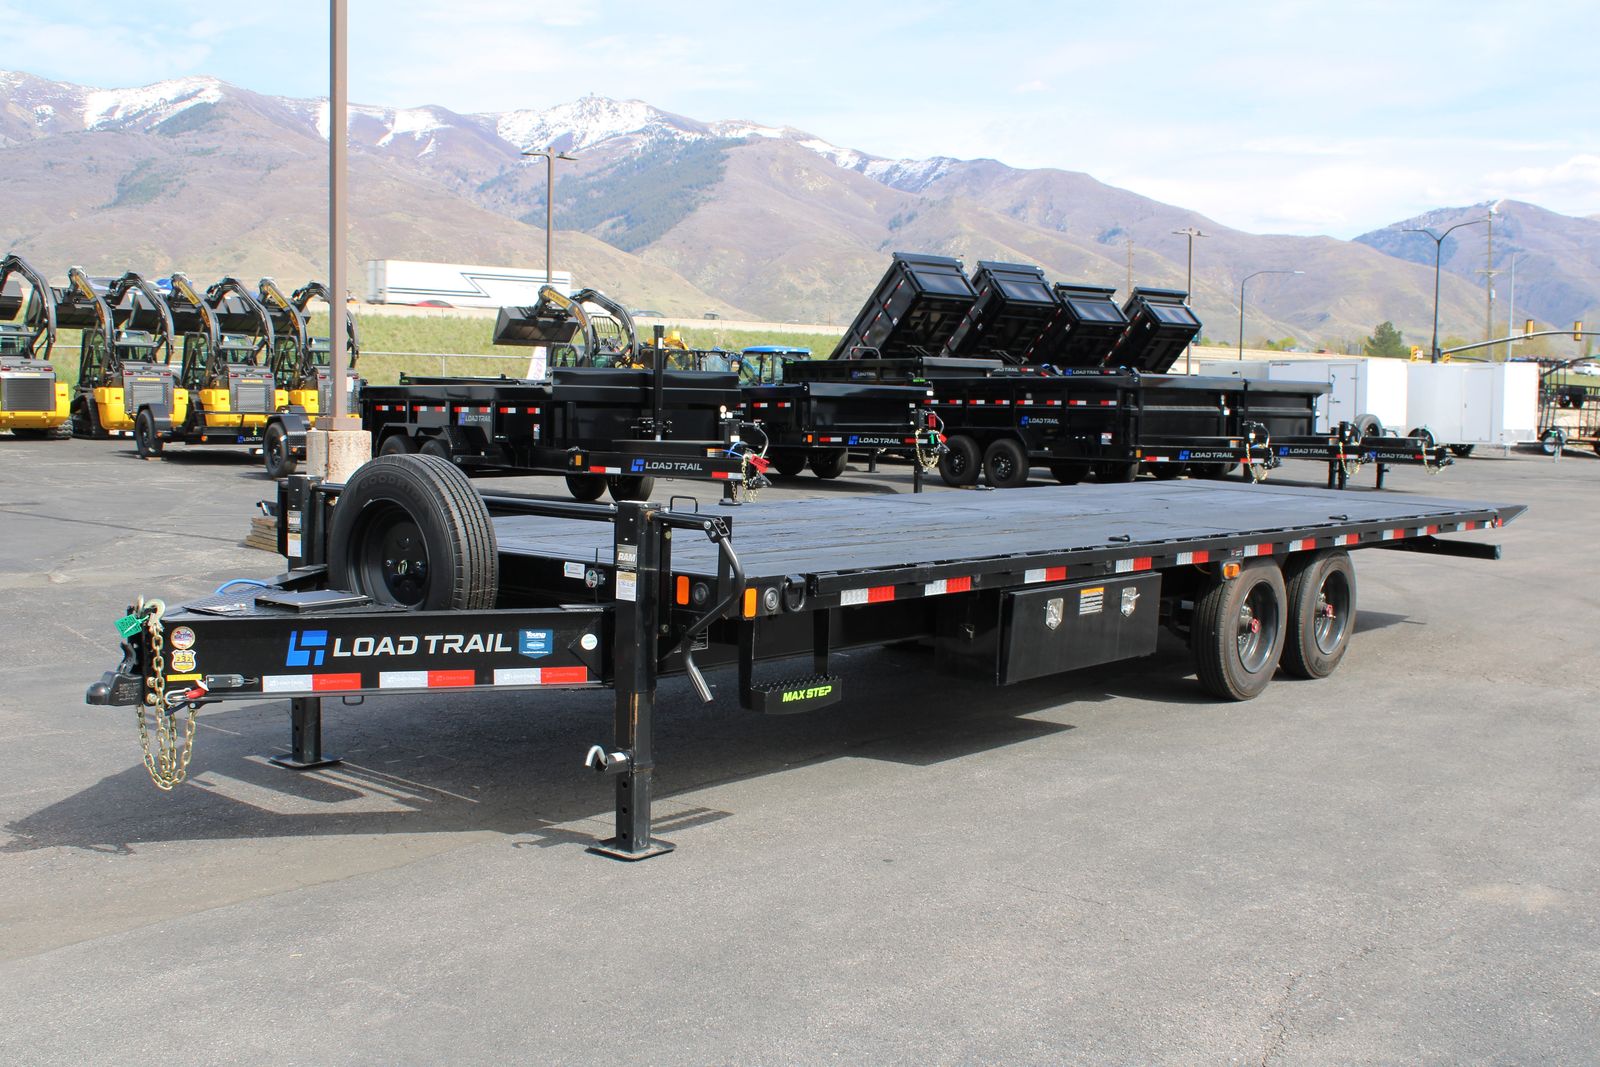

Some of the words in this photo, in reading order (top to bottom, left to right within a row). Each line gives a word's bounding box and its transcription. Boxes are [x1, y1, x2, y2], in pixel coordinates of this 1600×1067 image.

[879, 437, 901, 445] TRAIL
[645, 461, 673, 471] LOAD
[674, 463, 703, 471] TRAIL
[617, 552, 637, 562] RAM
[525, 631, 547, 639] Young
[333, 636, 419, 657] LOAD
[424, 633, 512, 655] TRAIL
[782, 689, 806, 702] MAX
[806, 685, 832, 699] STEP
